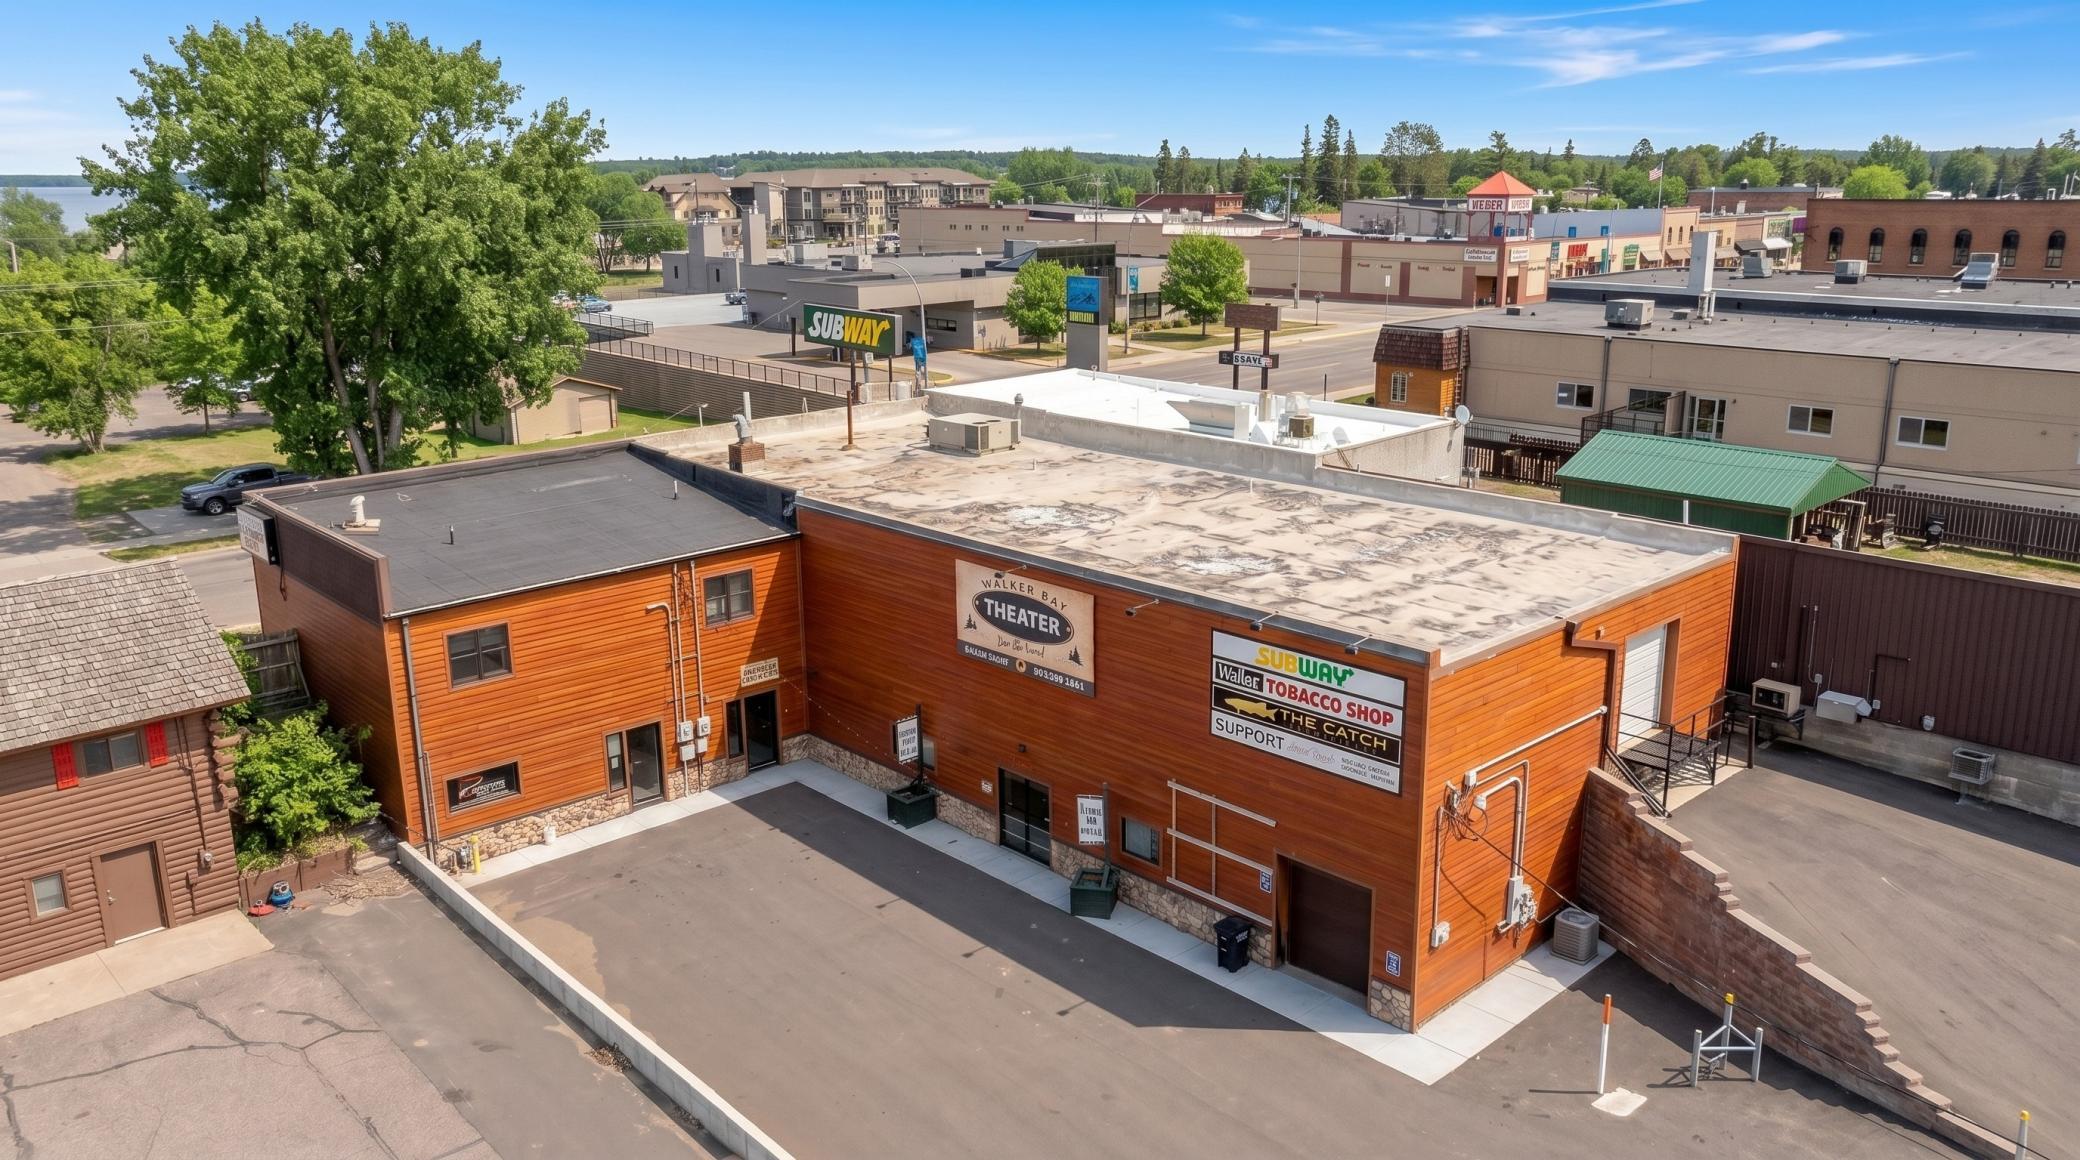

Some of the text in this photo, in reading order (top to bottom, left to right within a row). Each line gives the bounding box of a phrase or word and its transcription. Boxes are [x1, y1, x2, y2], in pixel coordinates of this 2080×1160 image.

[808, 311, 891, 347] SUBWAY
[981, 579, 1068, 611] WALKER BAY
[983, 598, 1061, 637] THEATER
[1255, 646, 1354, 687] SUBWAY
[1266, 678, 1342, 713] TOBACCO
[1346, 702, 1394, 727] SHOP
[1215, 717, 1285, 750] SUPPORT
[1279, 708, 1317, 730] THE
[1323, 722, 1387, 752] CATCH
